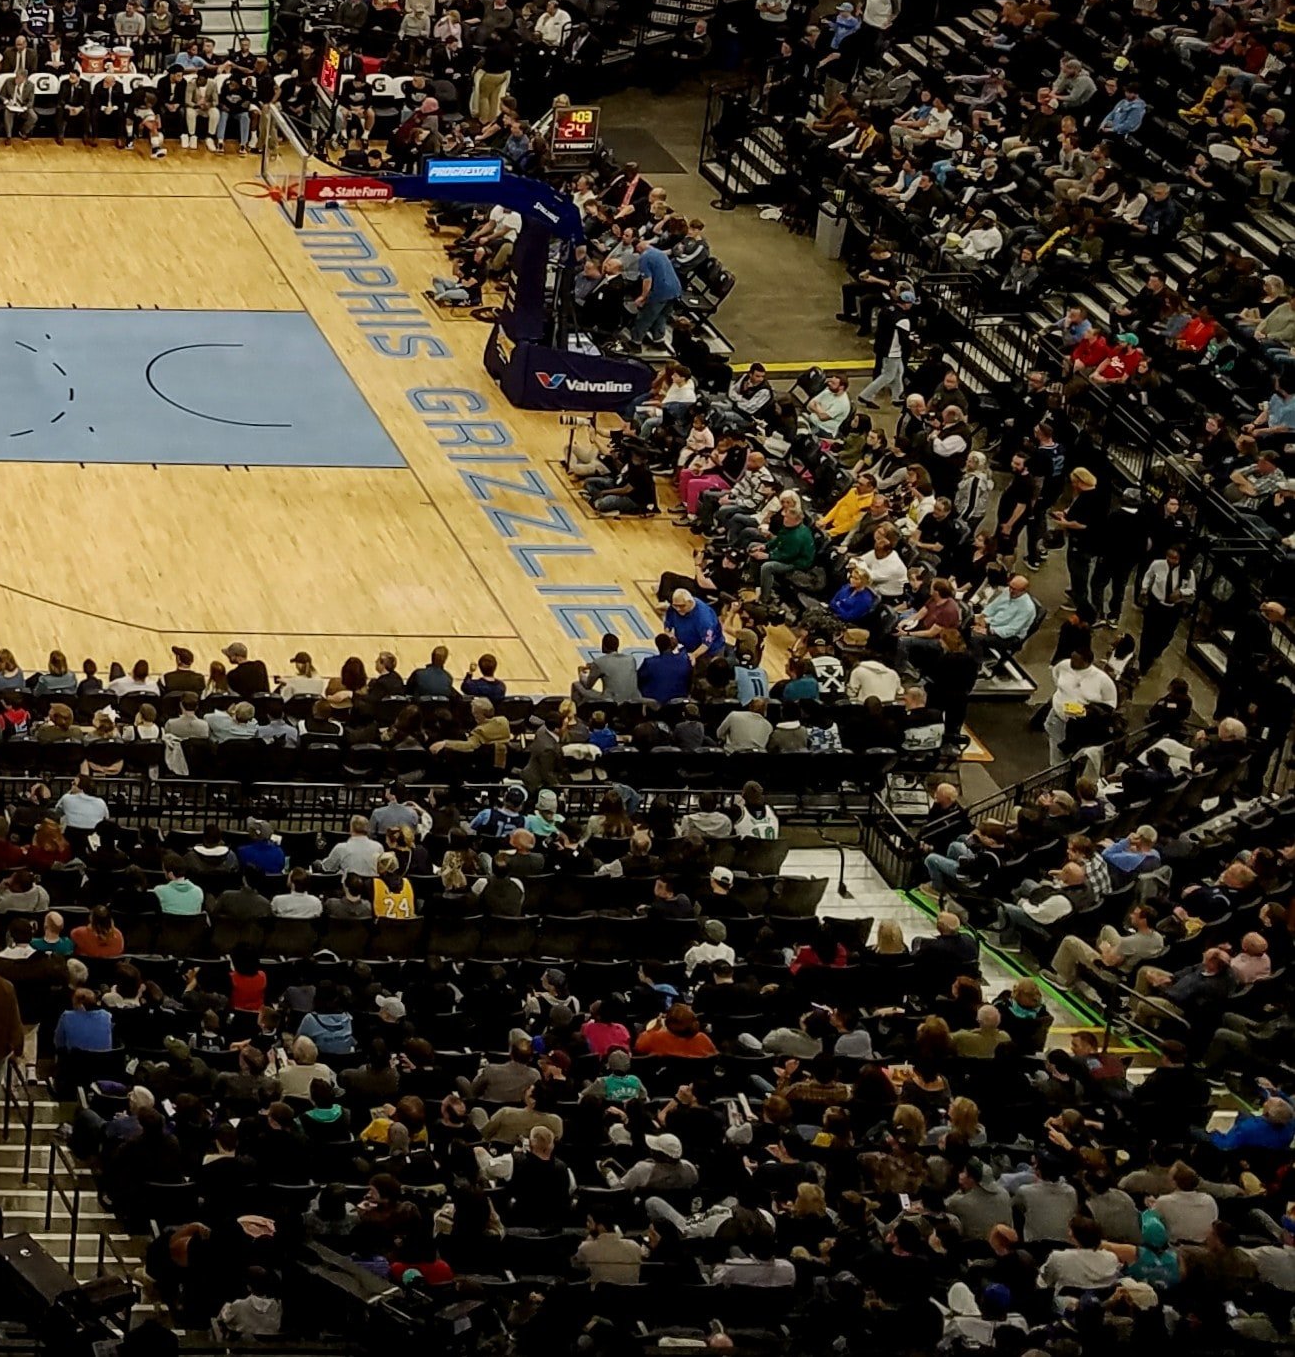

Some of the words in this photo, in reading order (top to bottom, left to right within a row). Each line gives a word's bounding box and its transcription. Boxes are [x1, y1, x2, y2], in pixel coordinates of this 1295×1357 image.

[564, 123, 586, 138] 24
[565, 378, 633, 393] Valvoline
[383, 897, 409, 918] 24
